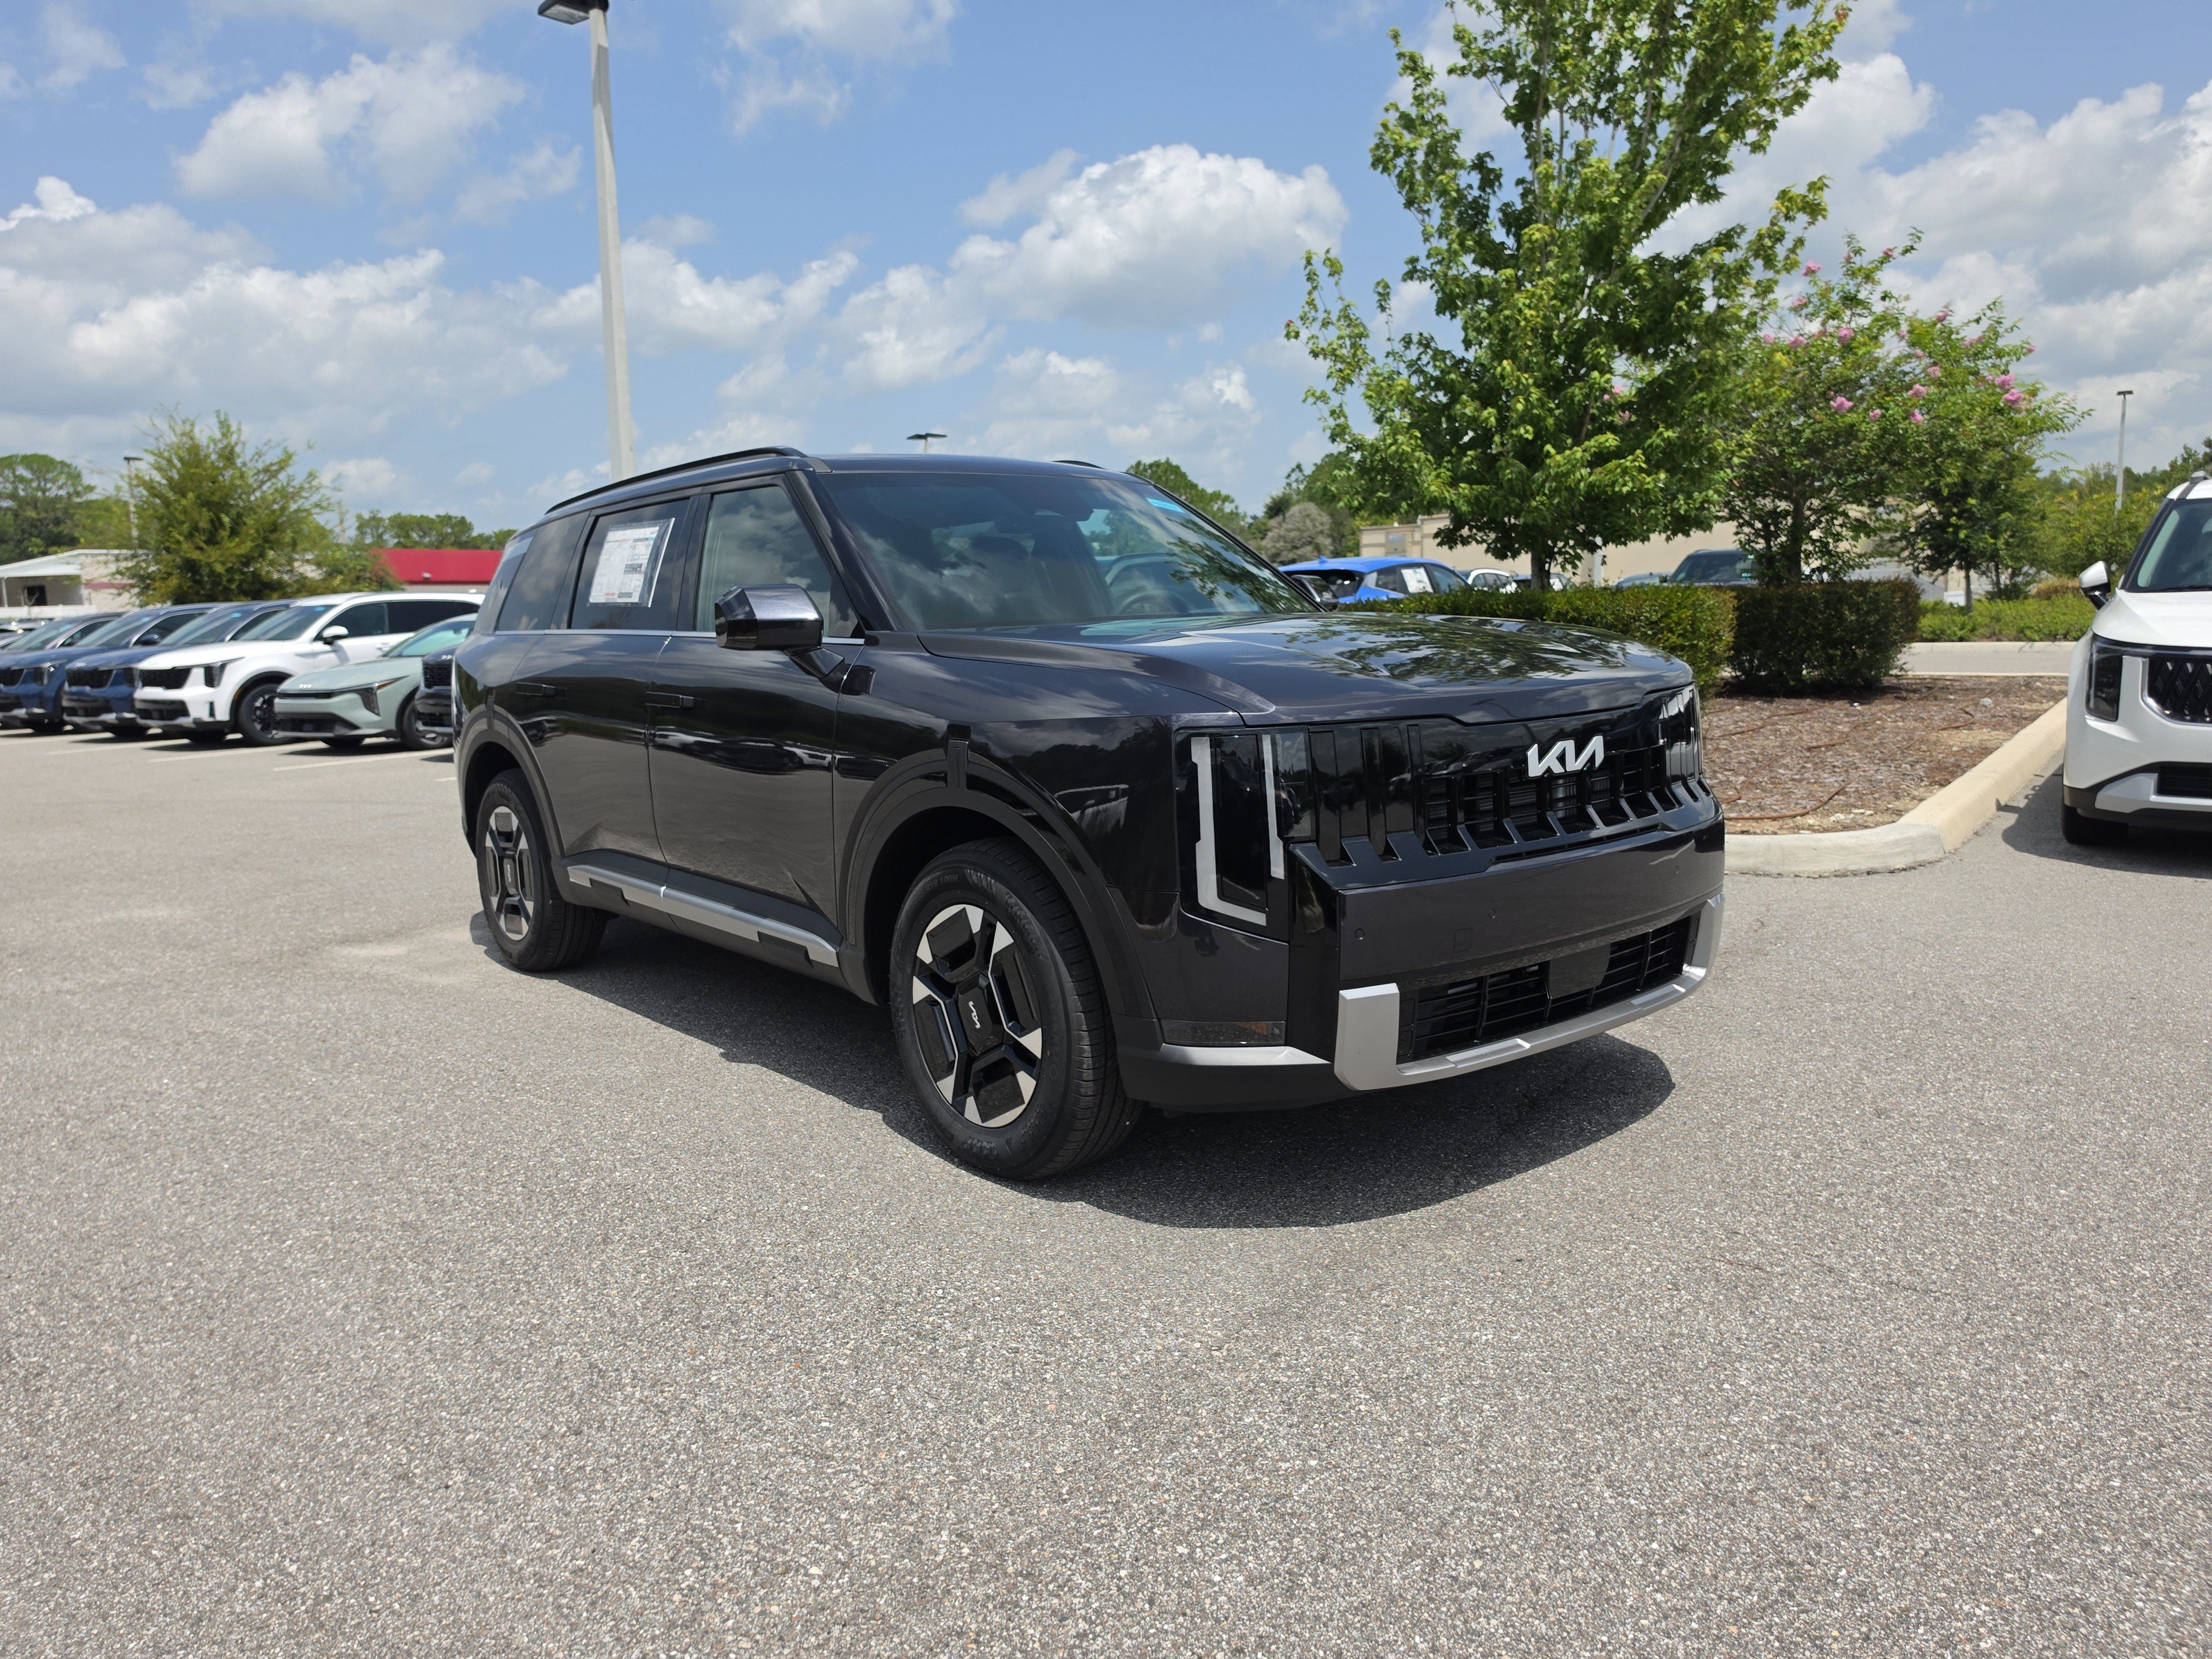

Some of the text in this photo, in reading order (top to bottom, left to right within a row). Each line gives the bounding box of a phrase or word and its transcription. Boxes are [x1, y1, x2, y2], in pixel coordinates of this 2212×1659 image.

[1527, 735, 1604, 777] KIA
[940, 874, 958, 884] 106H
[968, 1000, 981, 1029] KIA
